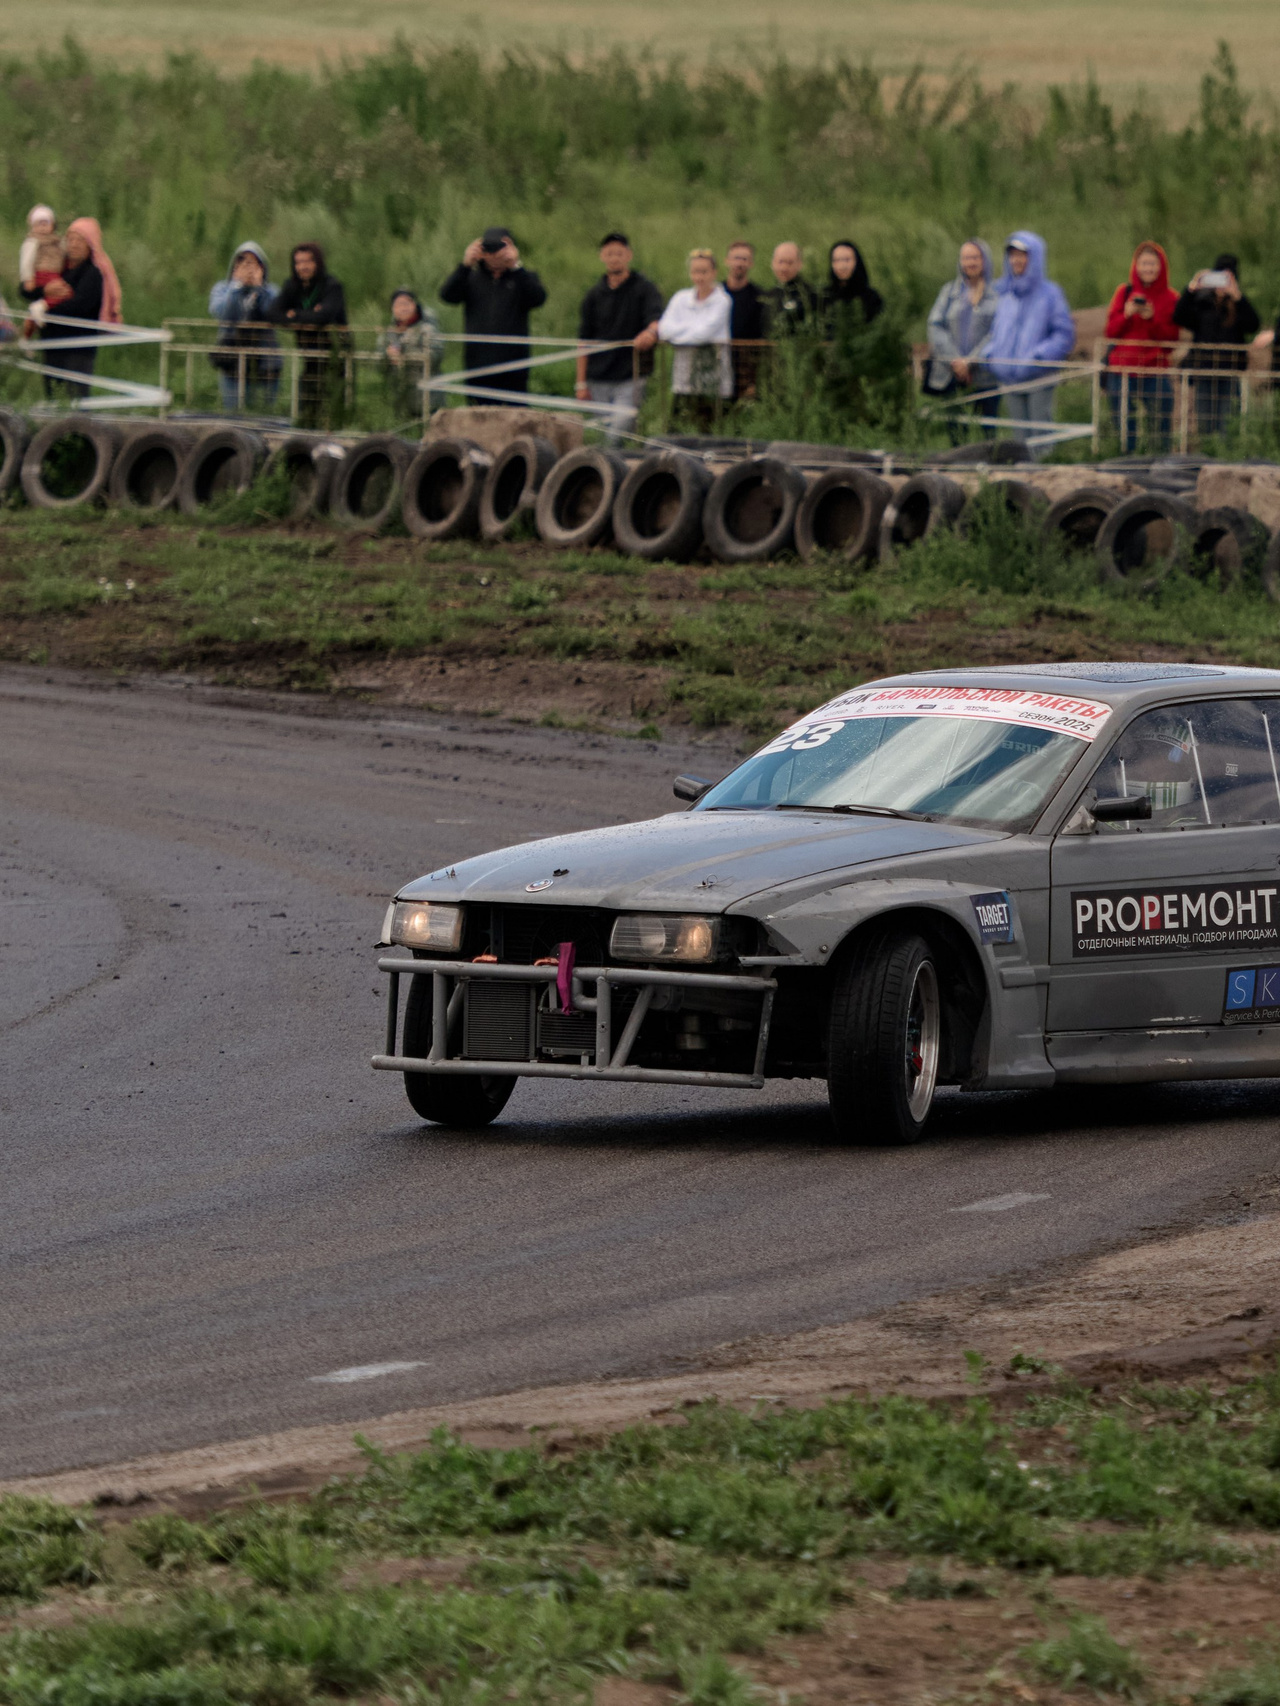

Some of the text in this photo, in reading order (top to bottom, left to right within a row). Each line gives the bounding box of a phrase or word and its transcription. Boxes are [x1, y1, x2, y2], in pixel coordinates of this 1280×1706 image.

[1019, 694, 1110, 720] РАКЕТЫ
[1018, 711, 1095, 732] СЕЗОН 2025
[975, 903, 1009, 926] TARGET
[1078, 936, 1137, 950] ОТДЕЛОЧНЫЕ
[1192, 931, 1227, 944] ПОДБОР
[1228, 930, 1235, 941] И
[1236, 928, 1278, 941] ПРОДАЖА
[1224, 1011, 1252, 1021] Service
[1254, 1009, 1261, 1019] &
